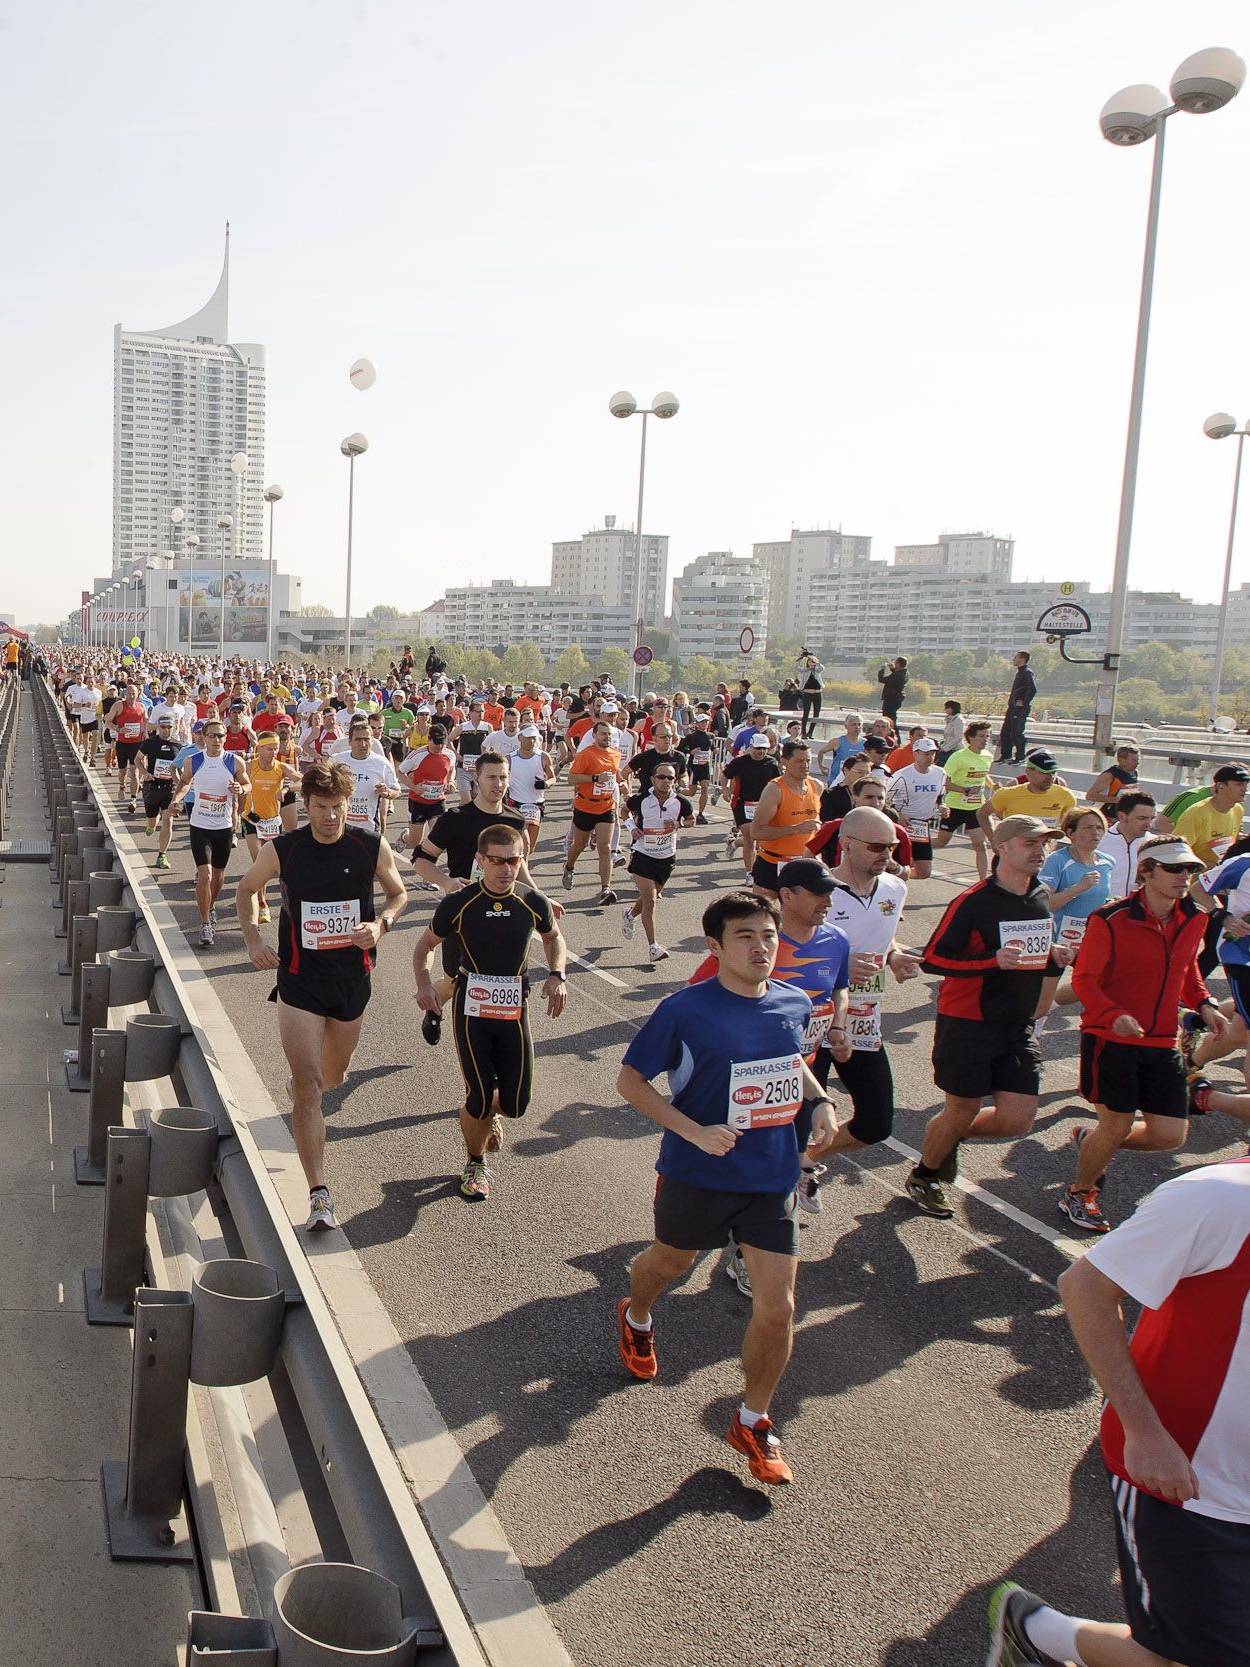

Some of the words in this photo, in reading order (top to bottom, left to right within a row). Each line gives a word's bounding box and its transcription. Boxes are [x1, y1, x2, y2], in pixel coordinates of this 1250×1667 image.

[914, 784, 937, 792] PKE
[351, 804, 368, 813] 6055
[310, 906, 341, 915] ERSTE
[305, 923, 326, 932] Hervis
[328, 916, 356, 934] 9371
[1002, 923, 1046, 932] SPARKASSE
[1069, 919, 1086, 927] ERS
[470, 974, 513, 983] SPARKASSE
[469, 989, 490, 1000] Hervis
[491, 988, 519, 1006] 6986
[800, 1043, 813, 1052] STE
[734, 1062, 791, 1077] SPARKASSE
[764, 1077, 799, 1105] 2508
[735, 1090, 762, 1102] Hervis
